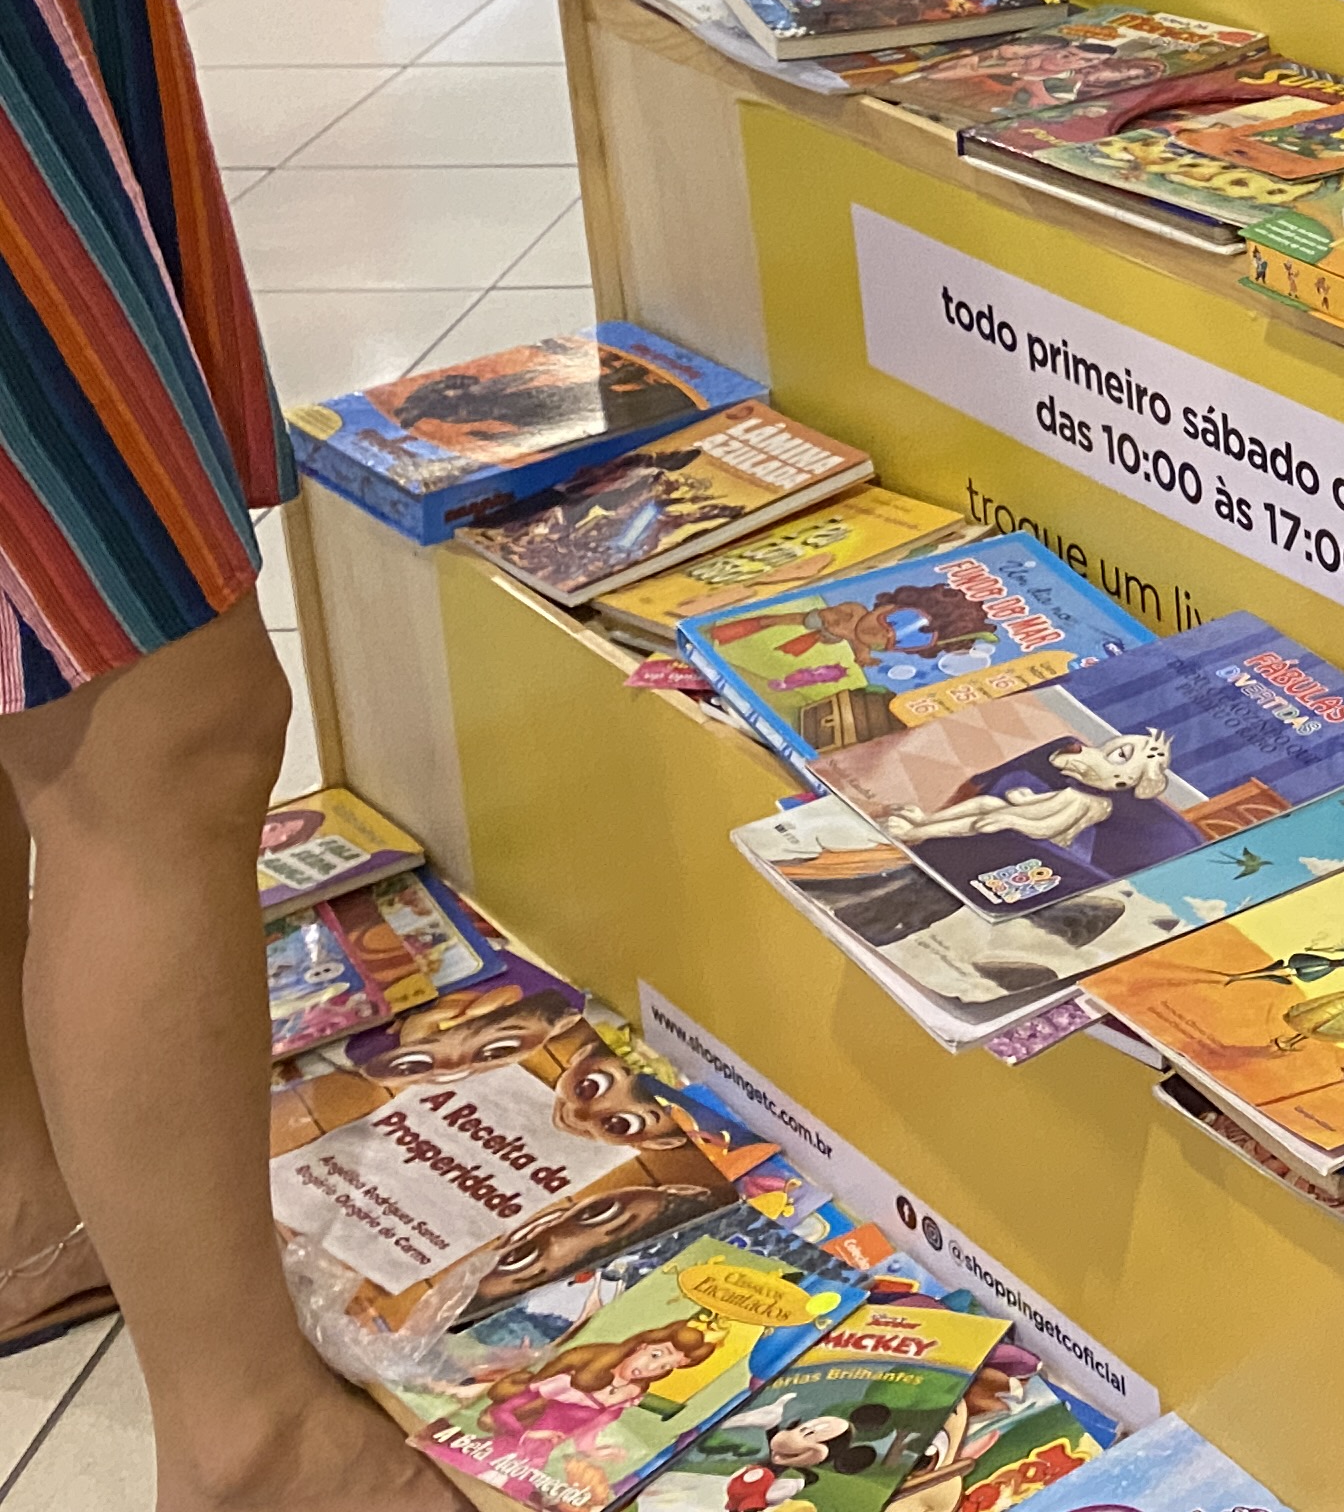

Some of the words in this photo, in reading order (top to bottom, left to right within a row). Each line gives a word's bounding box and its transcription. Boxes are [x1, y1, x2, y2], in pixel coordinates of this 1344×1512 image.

[942, 285, 1018, 353] todo
[1027, 331, 1172, 426] primeiro
[1182, 406, 1320, 495] sábado
[1035, 395, 1093, 453] das
[1101, 424, 1202, 505] 10:00
[1214, 475, 1255, 533] às
[933, 557, 1008, 602] FUNDO
[981, 594, 1030, 621] DO
[1100, 562, 1162, 626] um
[1000, 613, 1065, 653] MAR
[1216, 664, 1322, 737] DIVERTIDAS
[651, 1004, 833, 1160] www.shoppingetc.com.br
[371, 1110, 524, 1219] Prosperidade
[418, 1090, 458, 1112] A
[442, 1102, 538, 1171] Receita
[529, 1165, 572, 1195] da
[948, 1239, 1127, 1397] @shoppingetcoficial
[825, 1367, 925, 1386] Brilhantes
[432, 1426, 462, 1443] A
[449, 1434, 494, 1462] Bela
[488, 1452, 593, 1507] Adormecida
